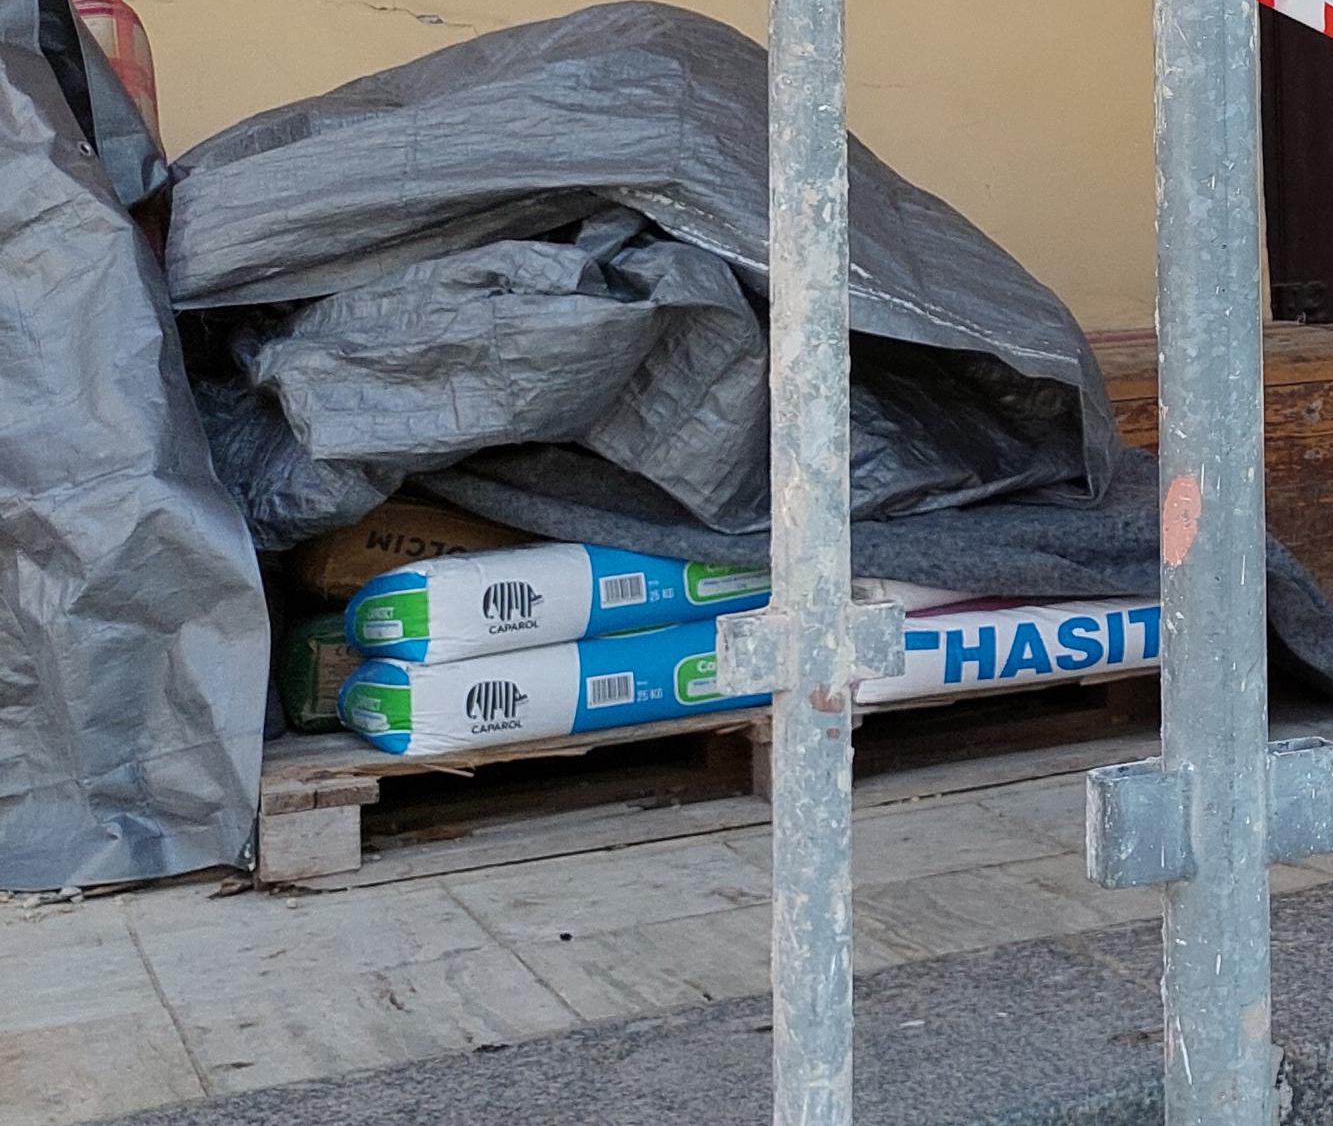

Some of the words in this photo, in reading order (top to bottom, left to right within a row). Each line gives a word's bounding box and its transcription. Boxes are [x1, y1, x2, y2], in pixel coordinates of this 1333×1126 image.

[488, 620, 539, 635] CAPAROL
[944, 606, 1161, 684] HASIT
[471, 720, 522, 734] CAPAROL
